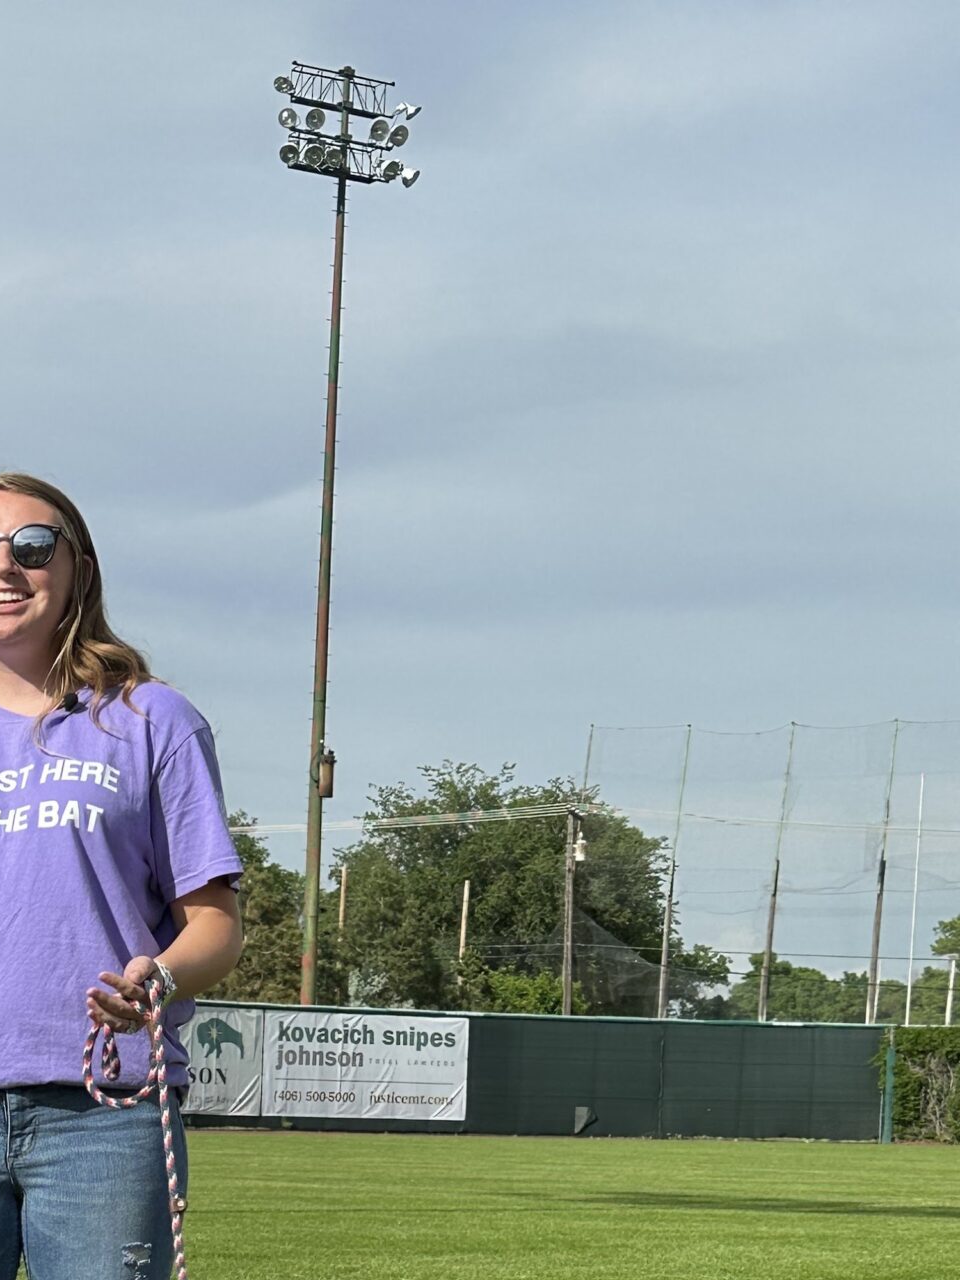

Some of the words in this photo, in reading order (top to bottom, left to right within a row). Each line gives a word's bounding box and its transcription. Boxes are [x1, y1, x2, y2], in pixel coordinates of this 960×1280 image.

[40, 759, 121, 793] HERE
[37, 800, 105, 833] BAT
[278, 1021, 374, 1045] kovacich
[382, 1026, 456, 1051] snipes
[275, 1045, 364, 1070] johnson
[274, 1090, 302, 1102] (406)
[306, 1091, 356, 1103] 500-5000
